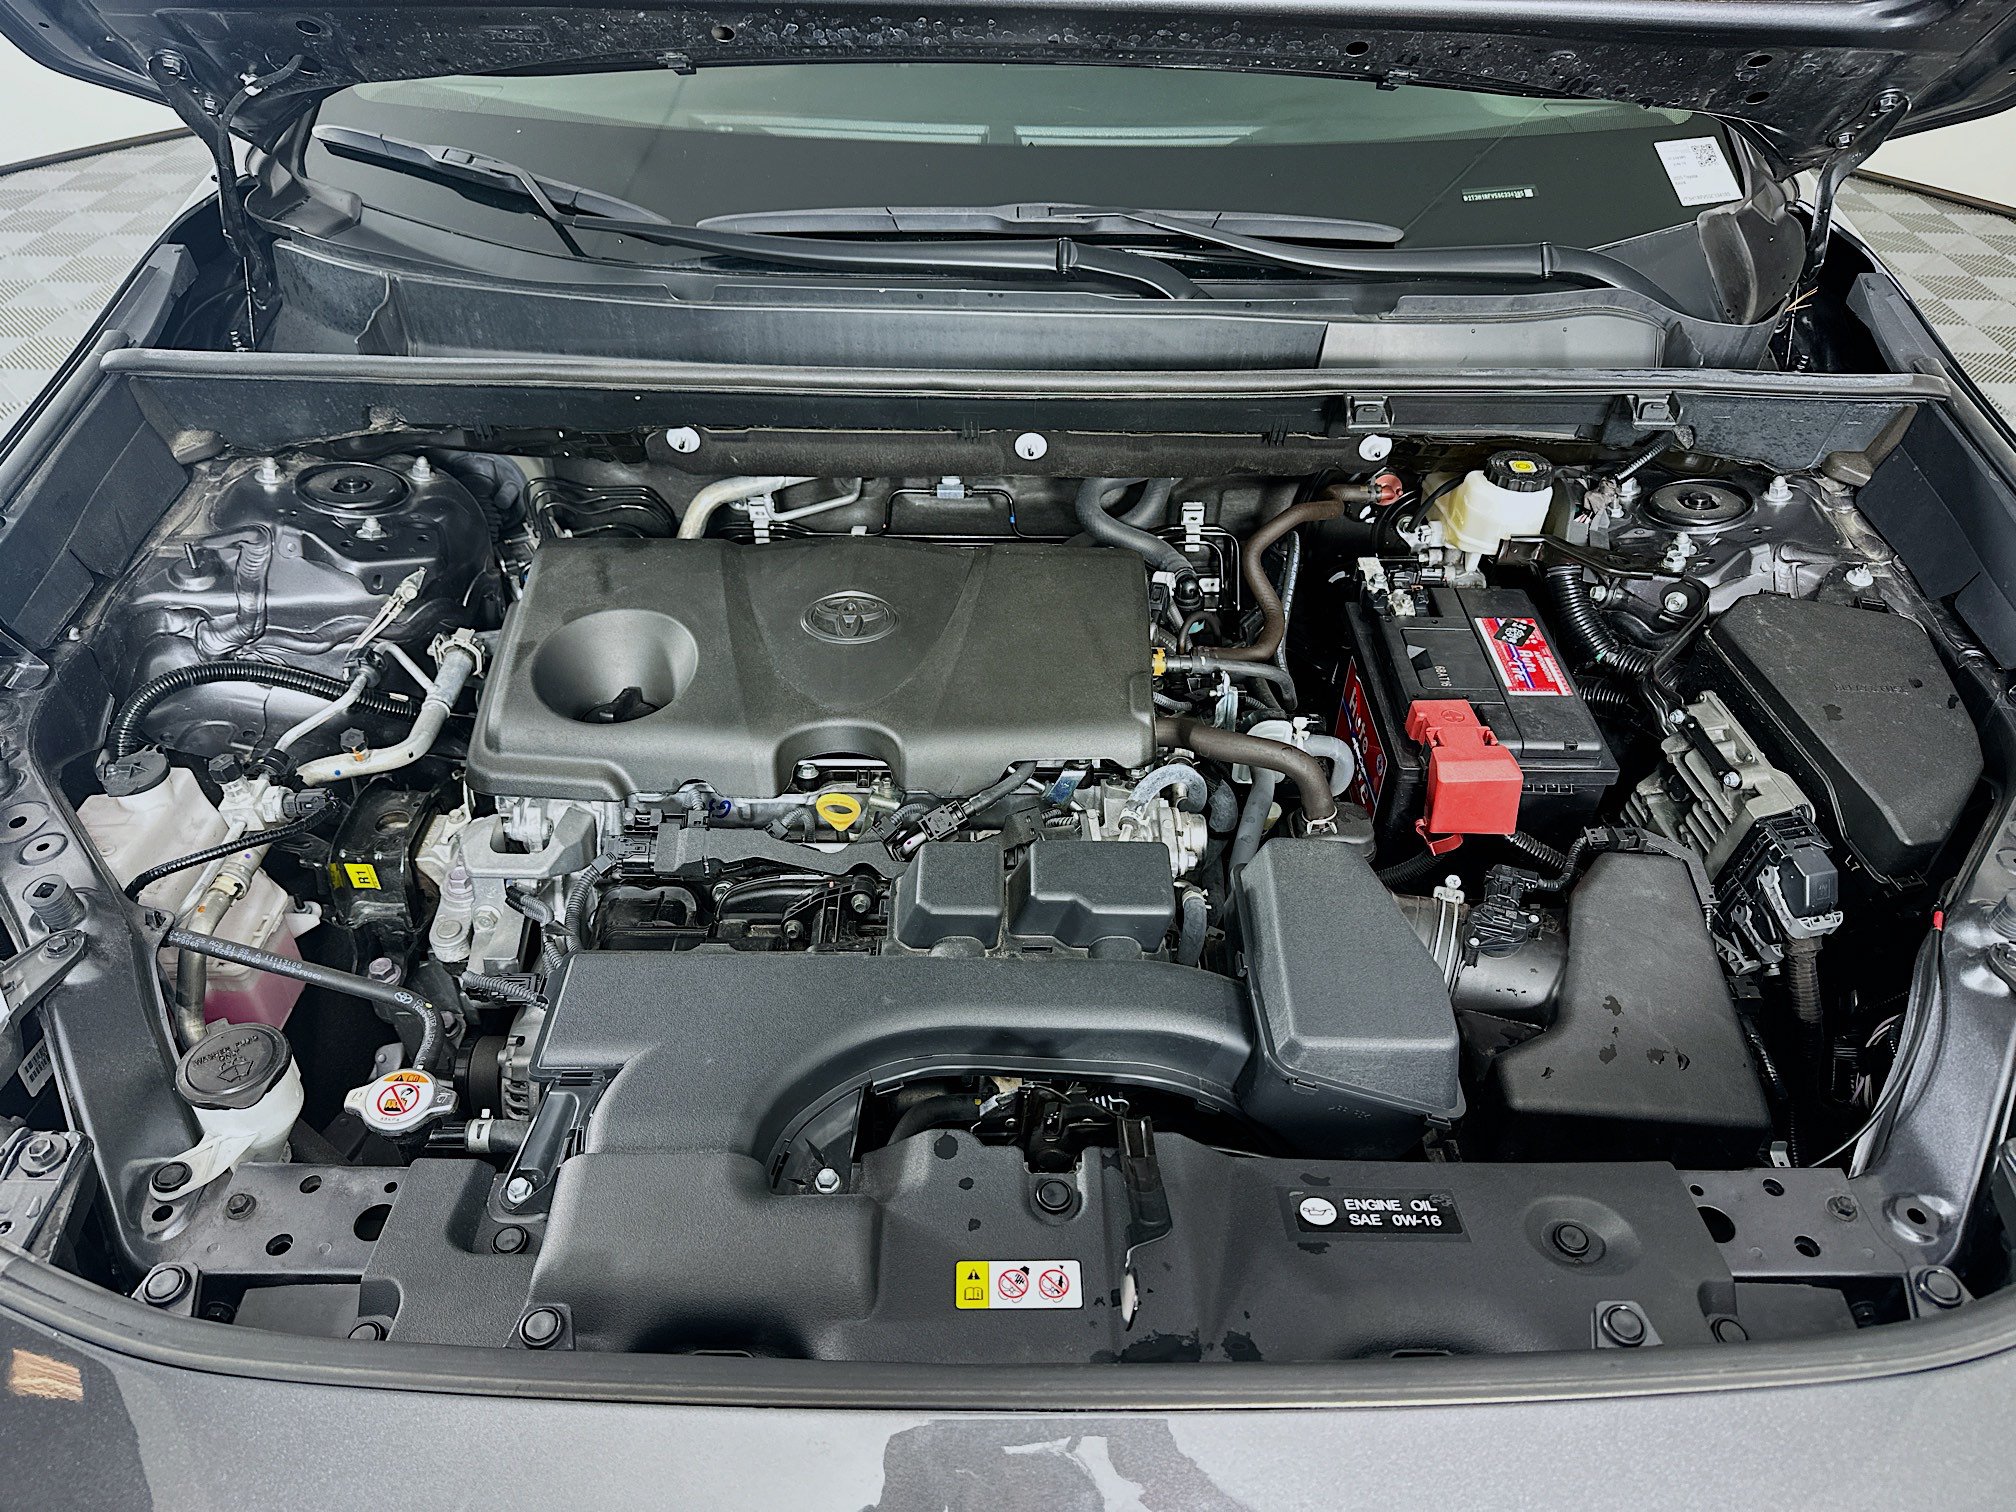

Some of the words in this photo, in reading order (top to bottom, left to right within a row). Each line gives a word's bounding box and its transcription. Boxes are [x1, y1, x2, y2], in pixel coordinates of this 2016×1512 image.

[356, 871, 370, 884] R1
[169, 929, 206, 944] 04/29/25
[208, 940, 223, 949] AGS
[193, 1046, 231, 1067] WASHER
[1343, 1198, 1403, 1211] ENGINE
[1410, 1199, 1438, 1212] OIL
[1348, 1213, 1383, 1227] SAE
[1391, 1214, 1443, 1227] 0W-16
